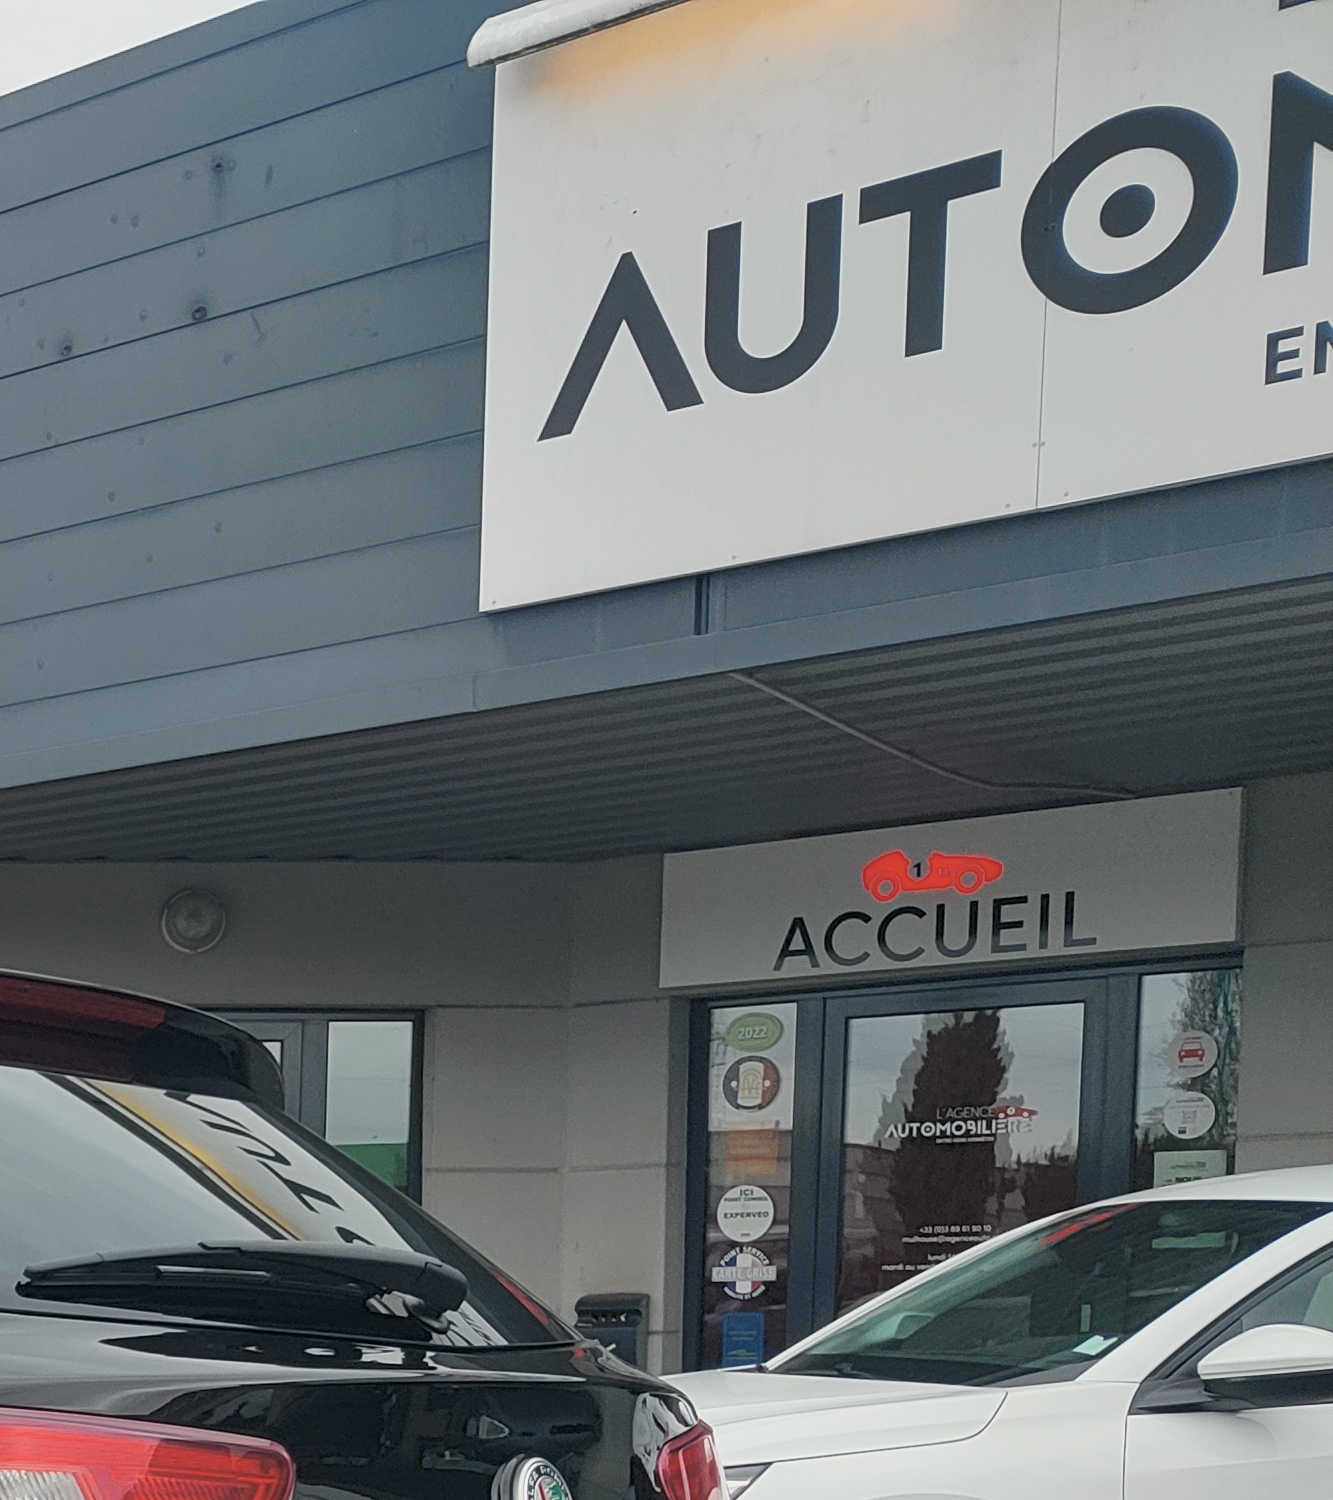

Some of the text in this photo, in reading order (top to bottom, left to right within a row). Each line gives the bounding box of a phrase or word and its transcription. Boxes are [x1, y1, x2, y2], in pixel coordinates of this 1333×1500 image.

[772, 891, 1098, 972] ACCUEIL
[737, 1027, 768, 1040] 2022
[936, 1106, 995, 1120] L'AGENCE
[739, 1189, 754, 1197] ICI
[745, 1267, 774, 1280] GRISE
